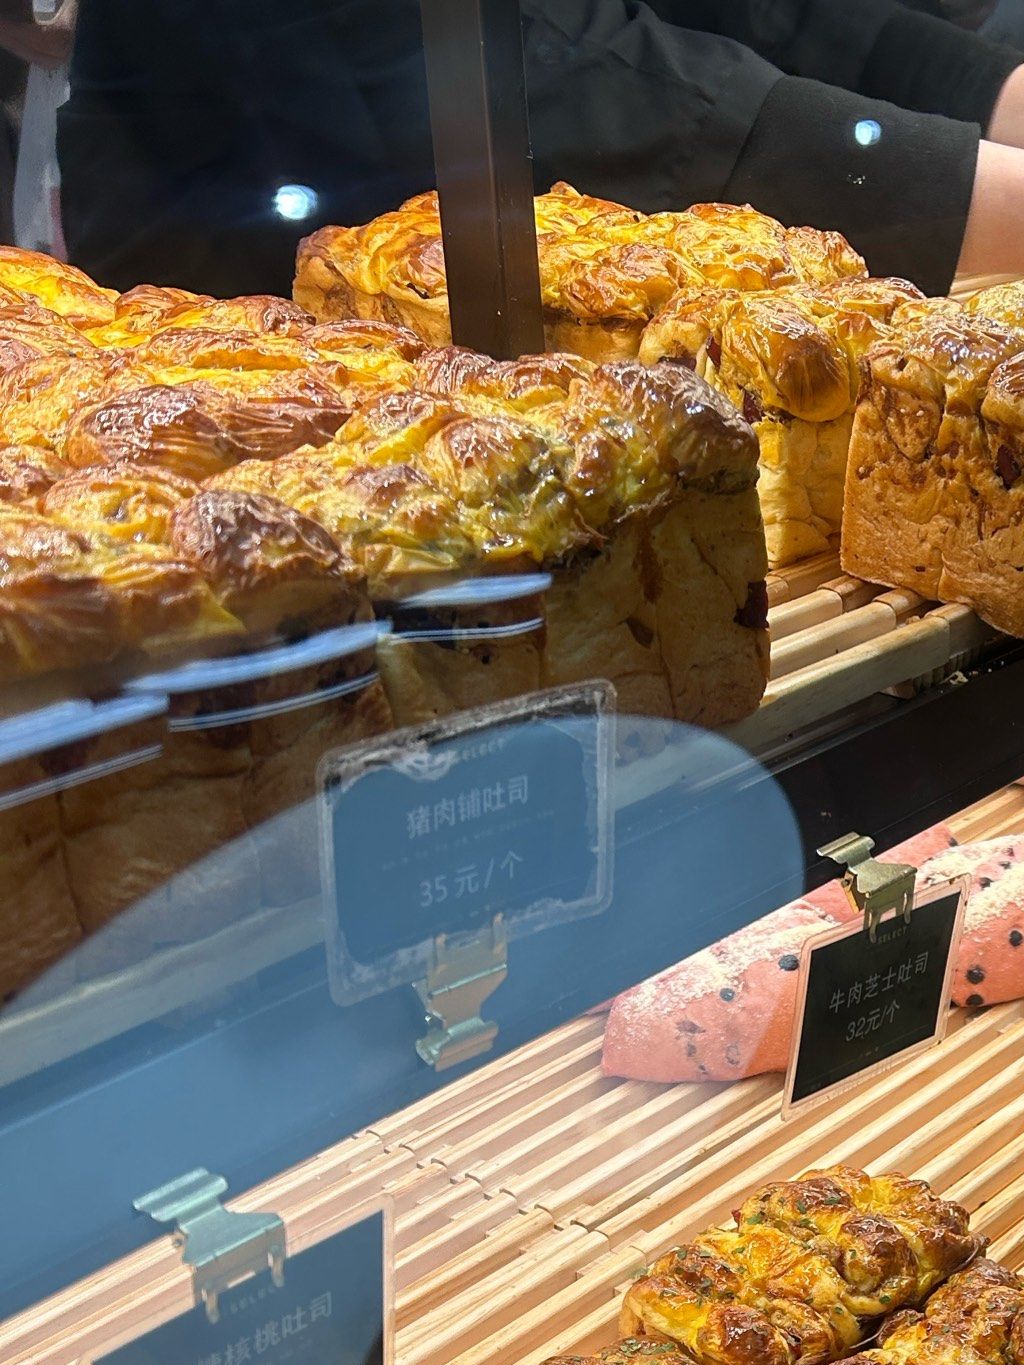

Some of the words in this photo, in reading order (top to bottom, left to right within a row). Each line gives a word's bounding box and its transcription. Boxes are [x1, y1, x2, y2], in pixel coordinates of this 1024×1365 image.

[418, 850, 524, 909] 35元/个
[828, 949, 929, 1014] 牛肉芝士吐司
[845, 998, 901, 1042] 32元/个
